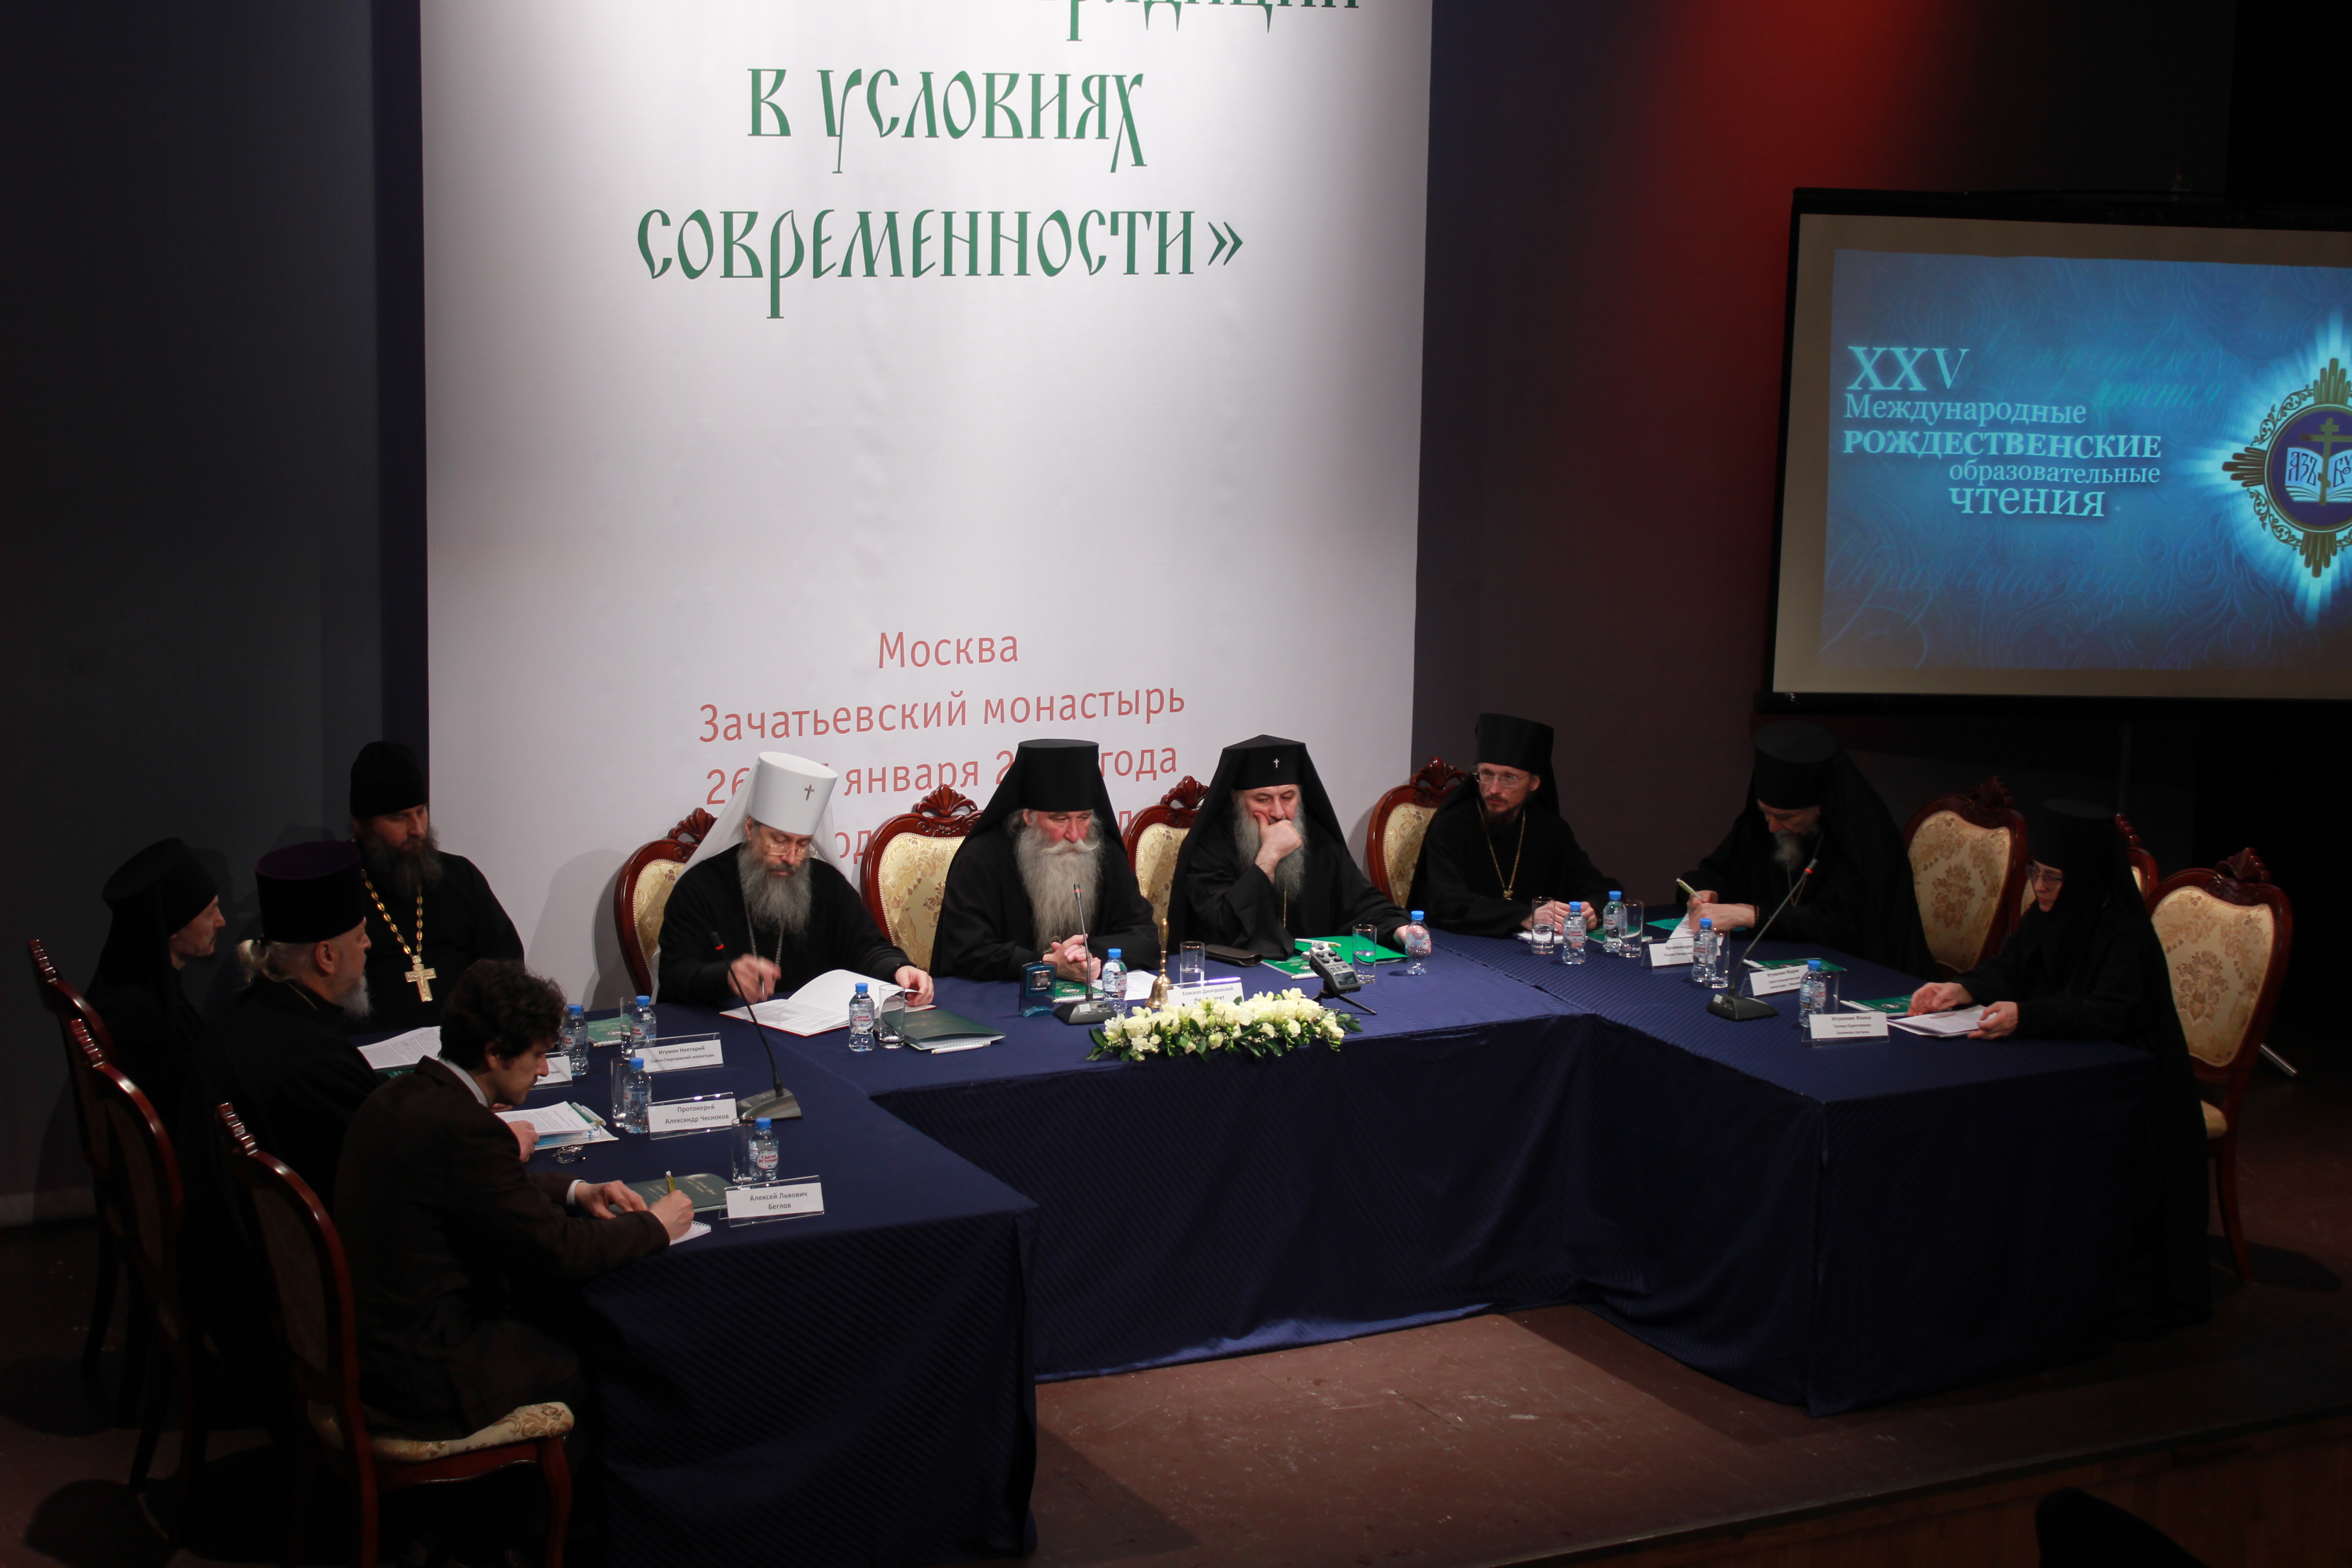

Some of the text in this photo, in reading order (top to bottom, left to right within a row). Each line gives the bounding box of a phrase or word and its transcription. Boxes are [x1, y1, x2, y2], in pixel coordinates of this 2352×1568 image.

[1848, 346, 1970, 391] XXV
[1844, 393, 2086, 426] Международные
[1842, 429, 2161, 459] РОЖДЕСТВЕНСКИЕ
[1949, 458, 2161, 485] образовательные
[879, 632, 1019, 669] Москва
[700, 687, 1186, 743] Зачатьевский монастырь
[844, 761, 979, 797] января
[1100, 747, 1177, 782] года
[1202, 986, 1234, 995] Дмитровский
[665, 1116, 699, 1124] Александр
[677, 1104, 715, 1113] Протоиерей
[750, 1192, 778, 1201] Алексей
